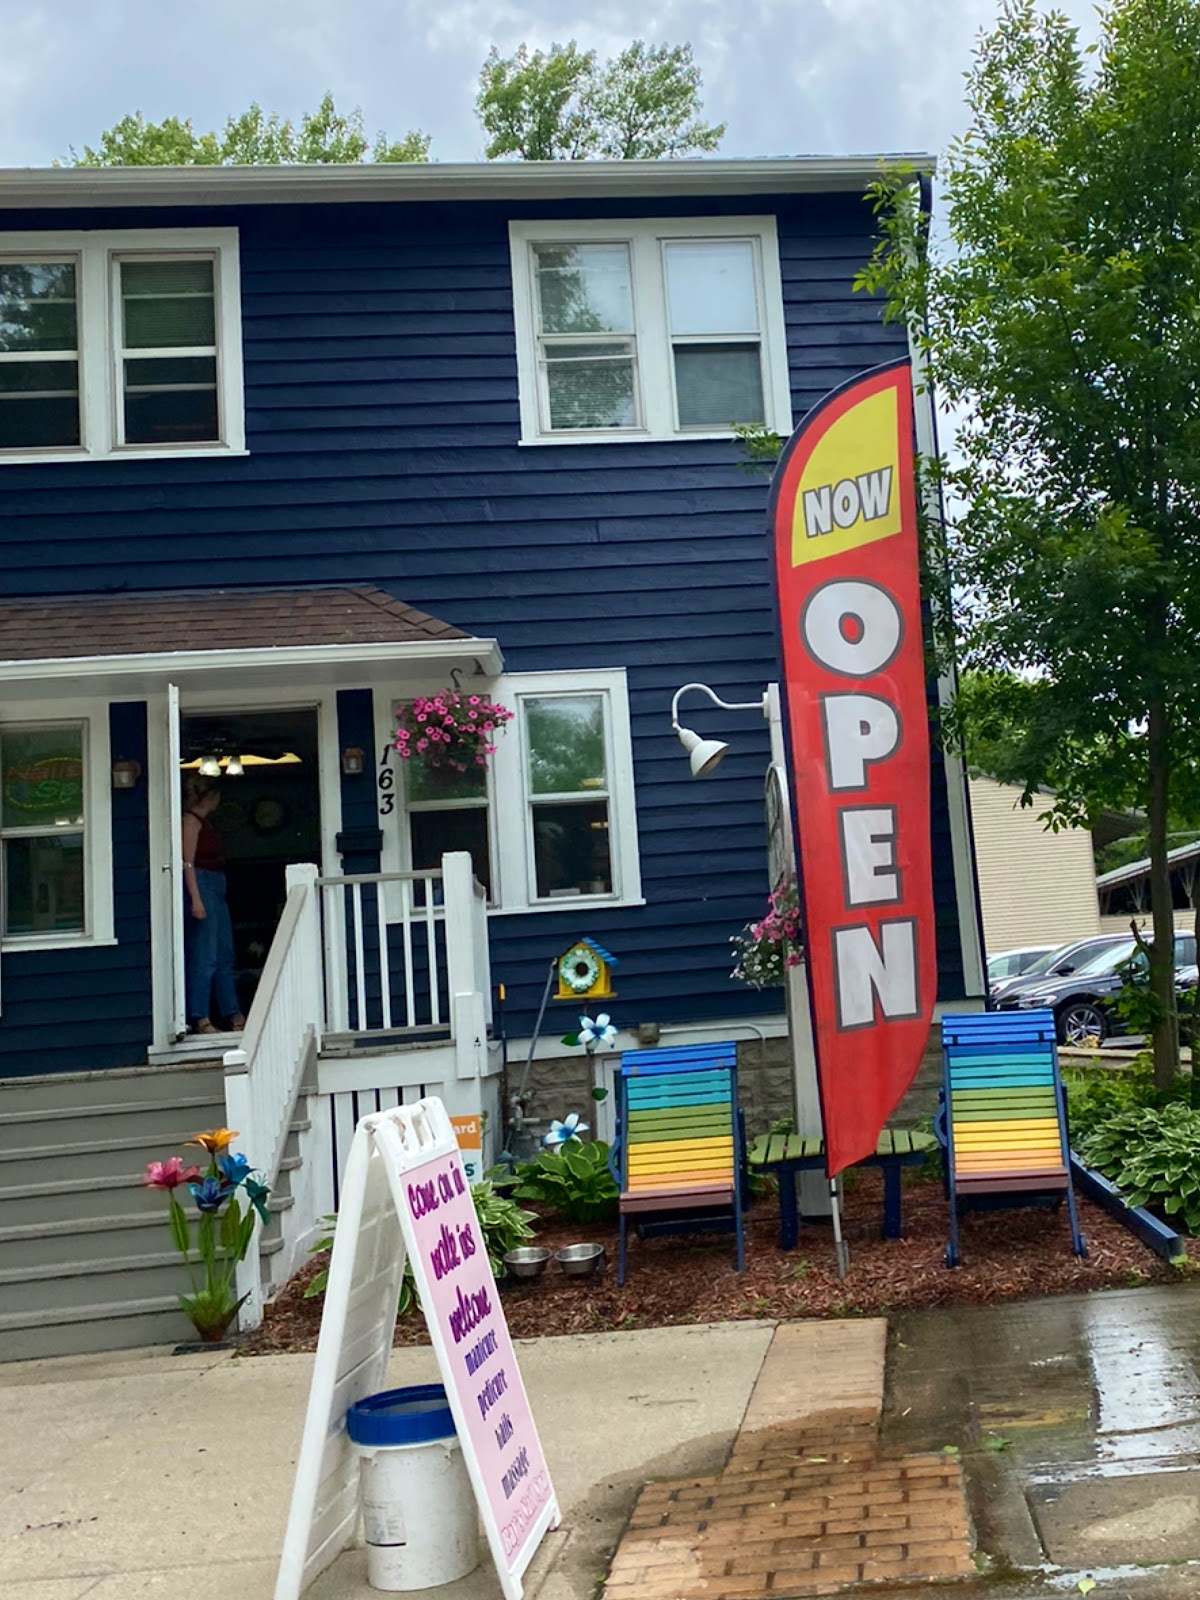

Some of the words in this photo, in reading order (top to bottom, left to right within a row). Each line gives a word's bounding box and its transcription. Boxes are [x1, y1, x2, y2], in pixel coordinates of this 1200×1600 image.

[802, 465, 893, 539] NOW
[379, 744, 394, 815] 163
[800, 577, 921, 1034] OPEN
[438, 1173, 454, 1204] on
[450, 1160, 465, 1196] in
[430, 1223, 461, 1281] walk
[456, 1223, 476, 1260] ins
[449, 1284, 492, 1345] welcome
[465, 1328, 498, 1377] manicure
[477, 1368, 508, 1422] pedicure
[501, 1446, 530, 1500] massage
